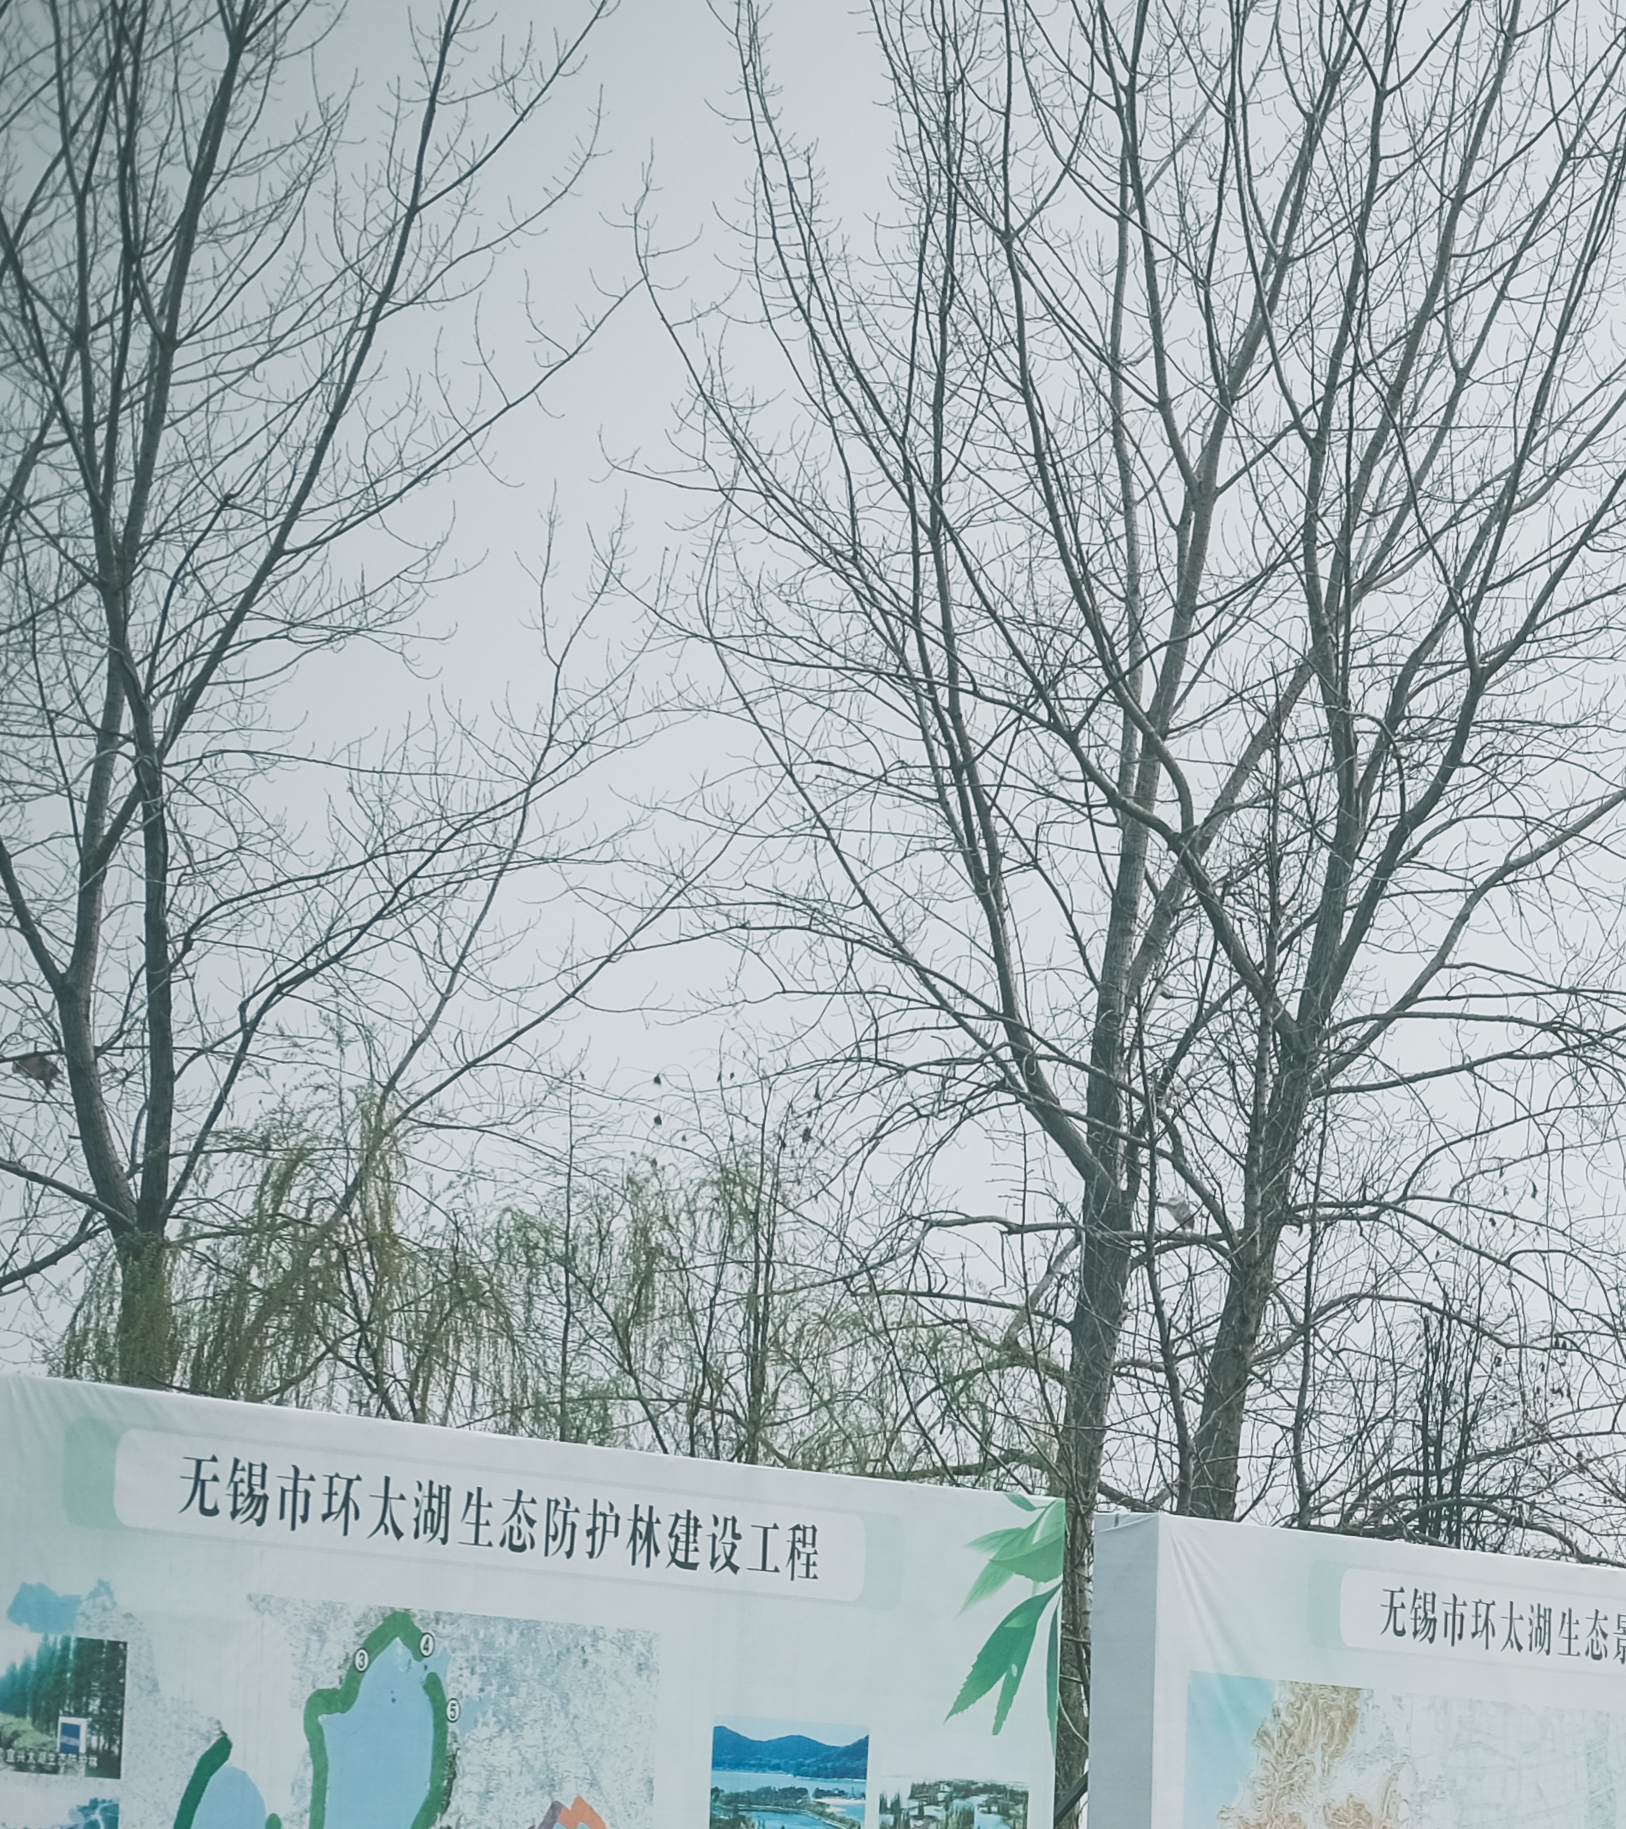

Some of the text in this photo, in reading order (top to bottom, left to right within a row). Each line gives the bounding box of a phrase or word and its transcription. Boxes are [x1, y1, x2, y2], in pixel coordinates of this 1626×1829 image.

[178, 1453, 820, 1582] 无锡市环太湖生态防护林建设工程
